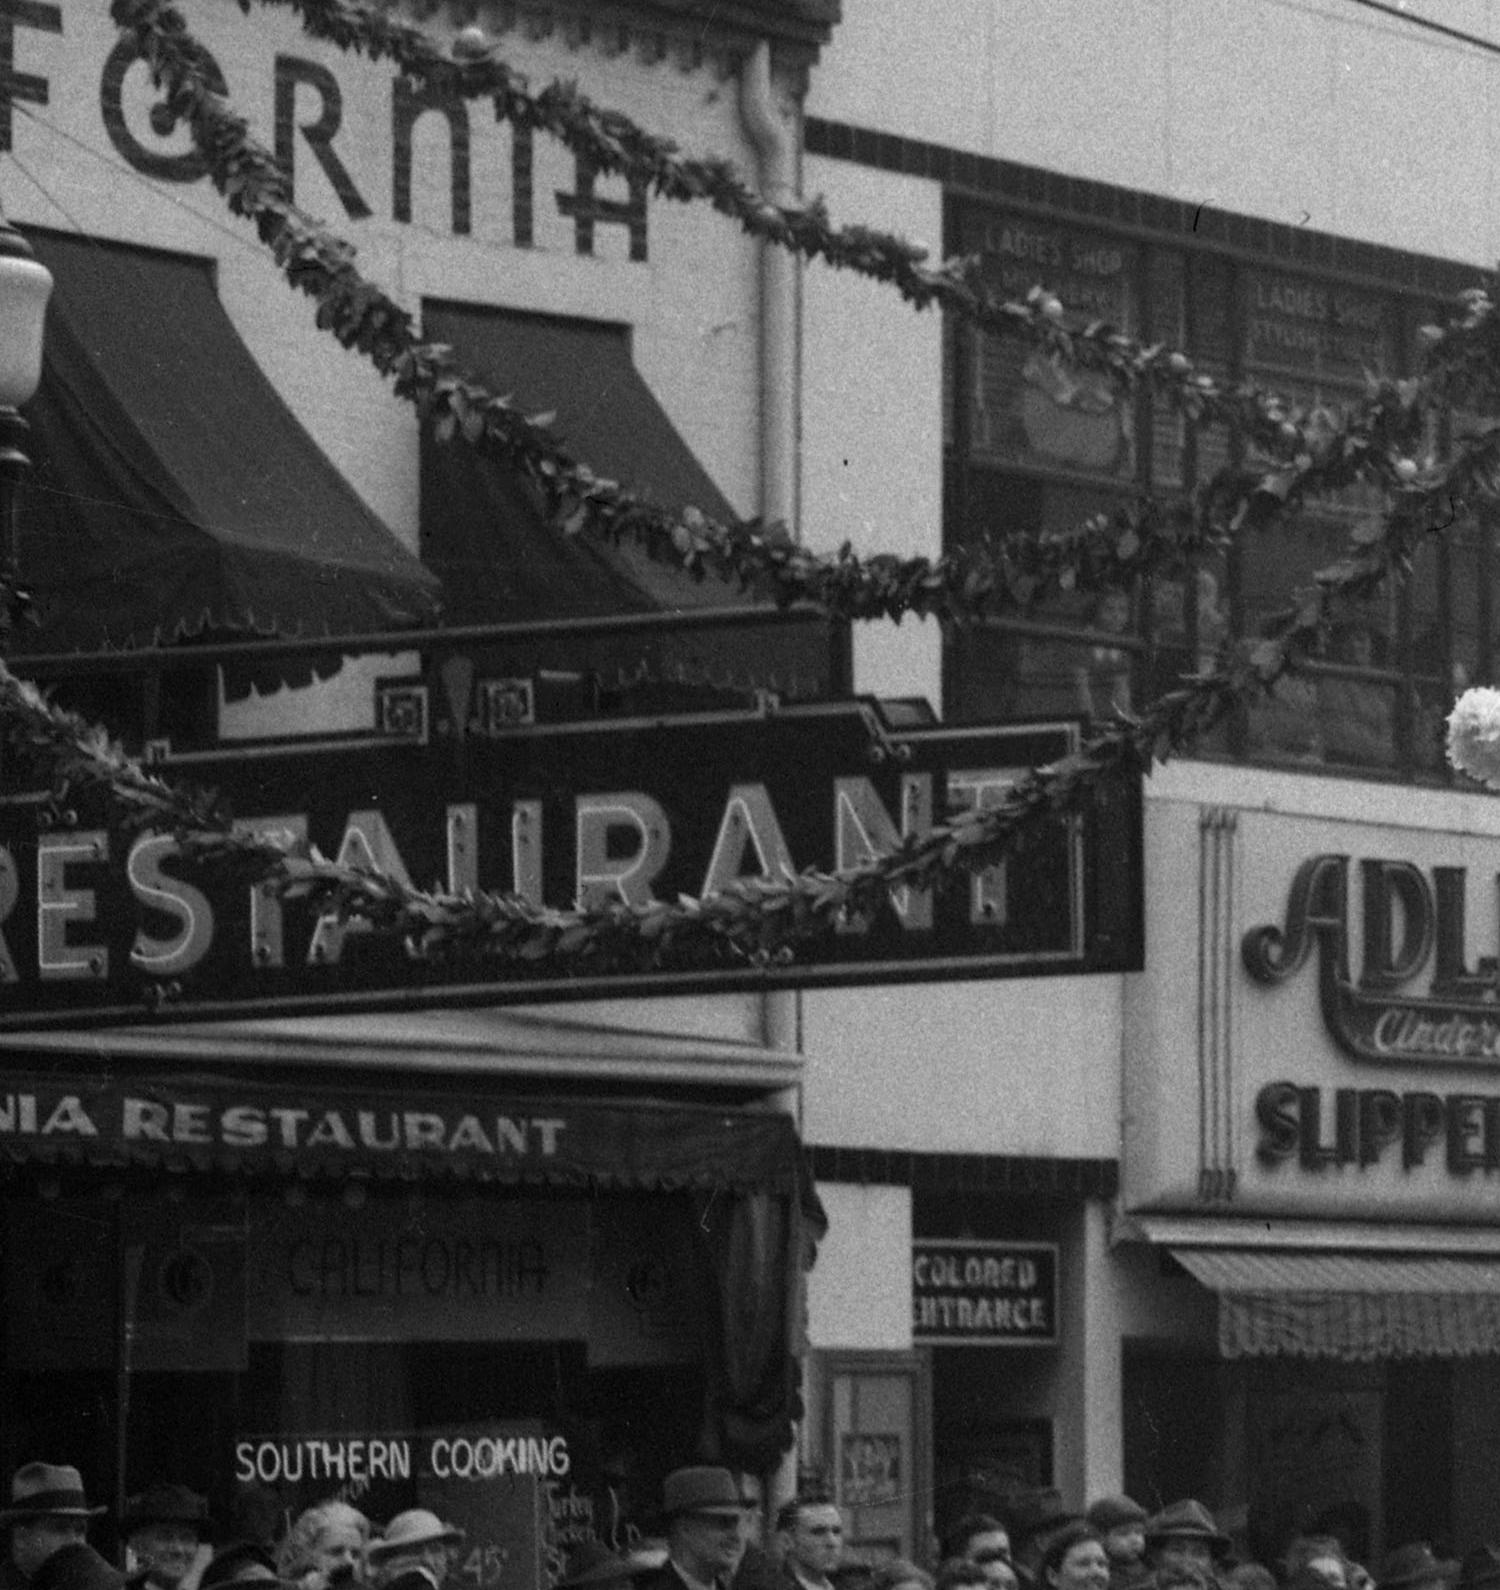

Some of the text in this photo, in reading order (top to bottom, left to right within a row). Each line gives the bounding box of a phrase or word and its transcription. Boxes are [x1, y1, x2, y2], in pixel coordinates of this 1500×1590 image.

[0, 766, 1030, 981] ESTAURANT
[122, 1098, 567, 1155] RESTAURANT
[289, 1234, 550, 1297] CALIFORNIA
[913, 1255, 1038, 1289] COLORED
[234, 1434, 571, 1484] SOUTHERN COOKING
